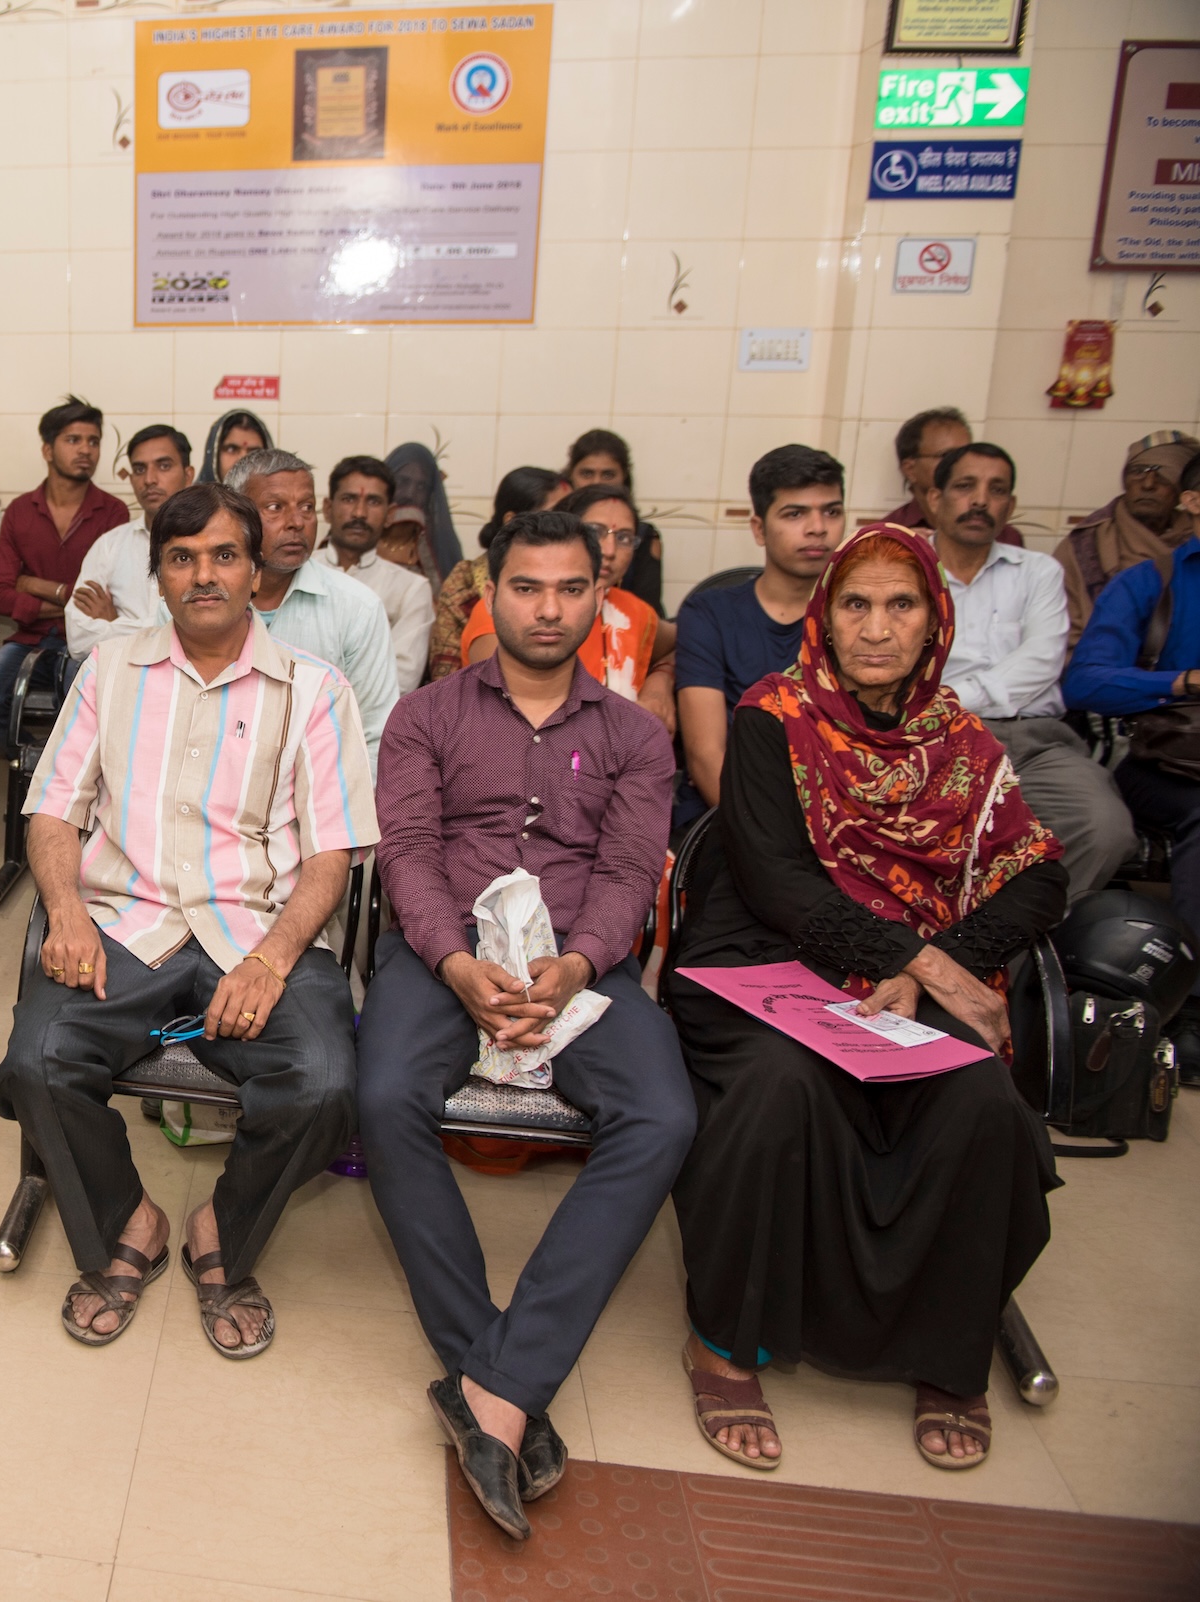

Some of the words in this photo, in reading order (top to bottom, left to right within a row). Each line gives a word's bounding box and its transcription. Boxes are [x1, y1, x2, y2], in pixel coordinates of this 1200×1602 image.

[201, 25, 253, 41] HIGHEST
[256, 24, 279, 39] EYE
[283, 23, 315, 37] CARE
[318, 20, 365, 36] AWARD
[368, 19, 394, 34] FOR
[431, 18, 448, 31] TO
[452, 16, 488, 31] SEWA
[492, 15, 535, 30] SADAN
[880, 75, 935, 98] Fire
[878, 101, 931, 125] exit
[1146, 116, 1160, 127] To
[1129, 190, 1176, 201] Providing
[1130, 205, 1149, 213] and
[1152, 204, 1181, 214] needy
[546, 1005, 580, 1038] ERYONE
[499, 1068, 520, 1084] TIME
